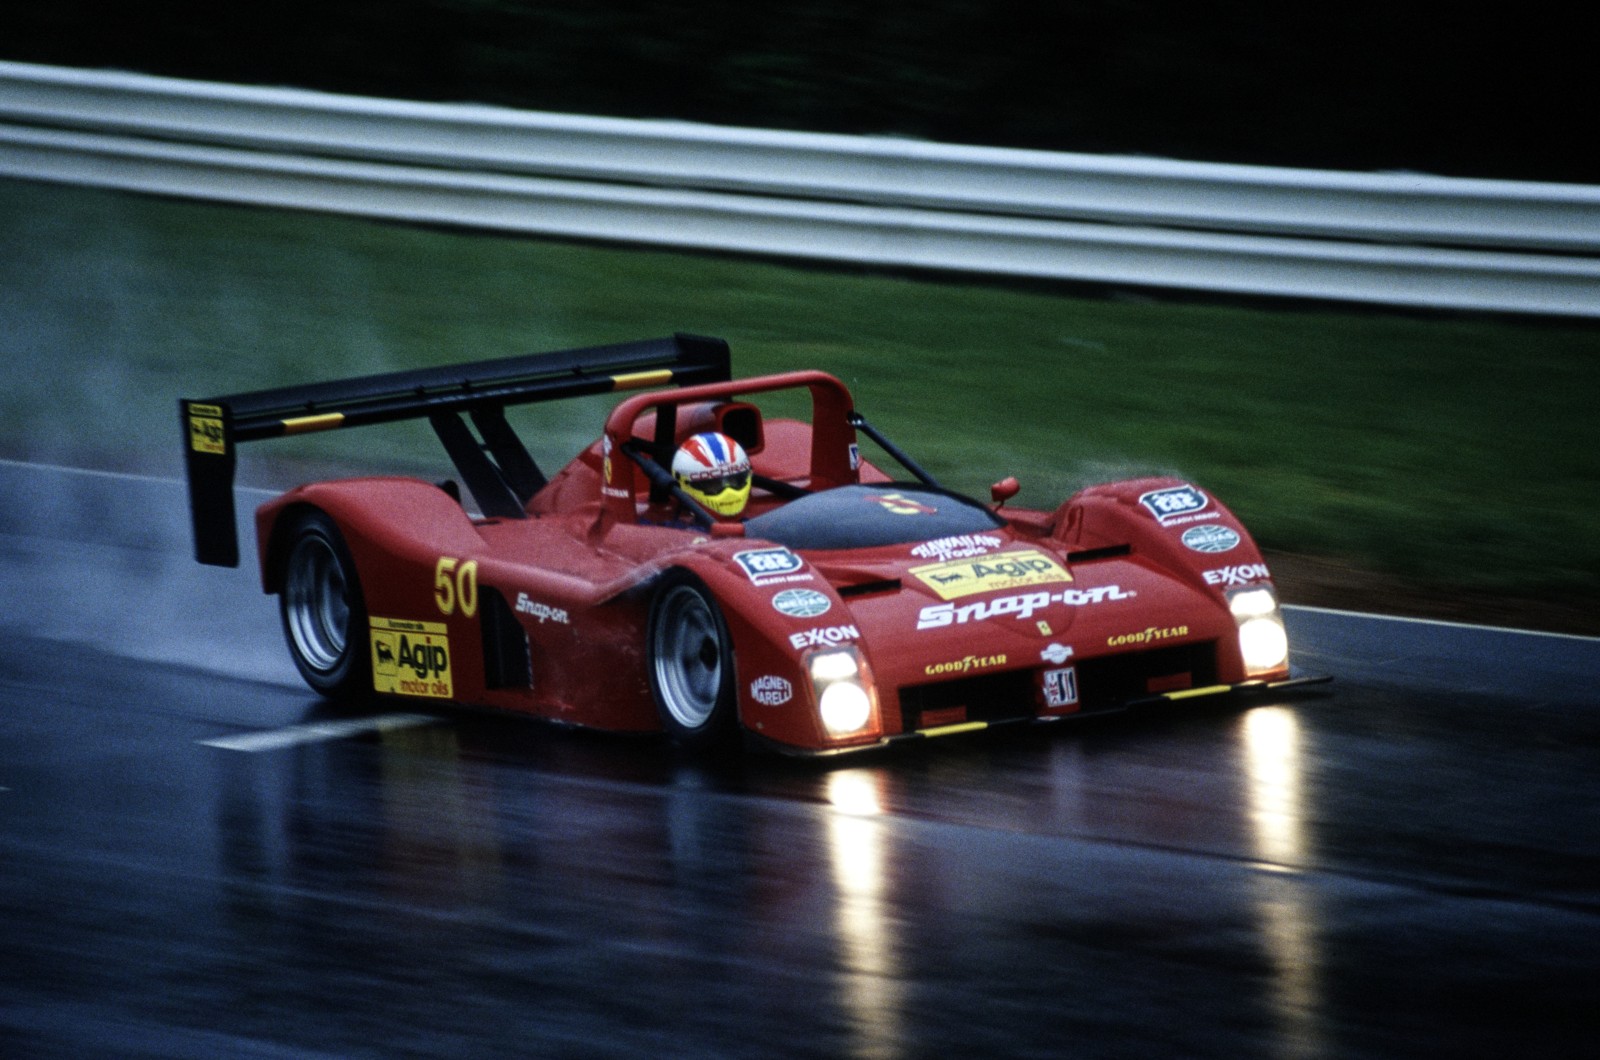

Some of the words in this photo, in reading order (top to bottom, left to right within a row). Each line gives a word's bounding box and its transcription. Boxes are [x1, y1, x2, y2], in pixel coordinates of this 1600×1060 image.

[911, 535, 1001, 558] HAWAIIAN
[972, 558, 1053, 579] Agip
[1202, 563, 1270, 585] EXXON
[434, 556, 478, 618] 50
[515, 592, 568, 624] Snap-on
[917, 585, 1130, 630] Snap-on
[789, 625, 860, 650] EXXON
[1107, 625, 1189, 647] GOODYEAR
[398, 634, 448, 679] Agip
[925, 654, 1007, 675] GOODYEAR
[401, 680, 429, 694] motor
[431, 681, 449, 696] oils
